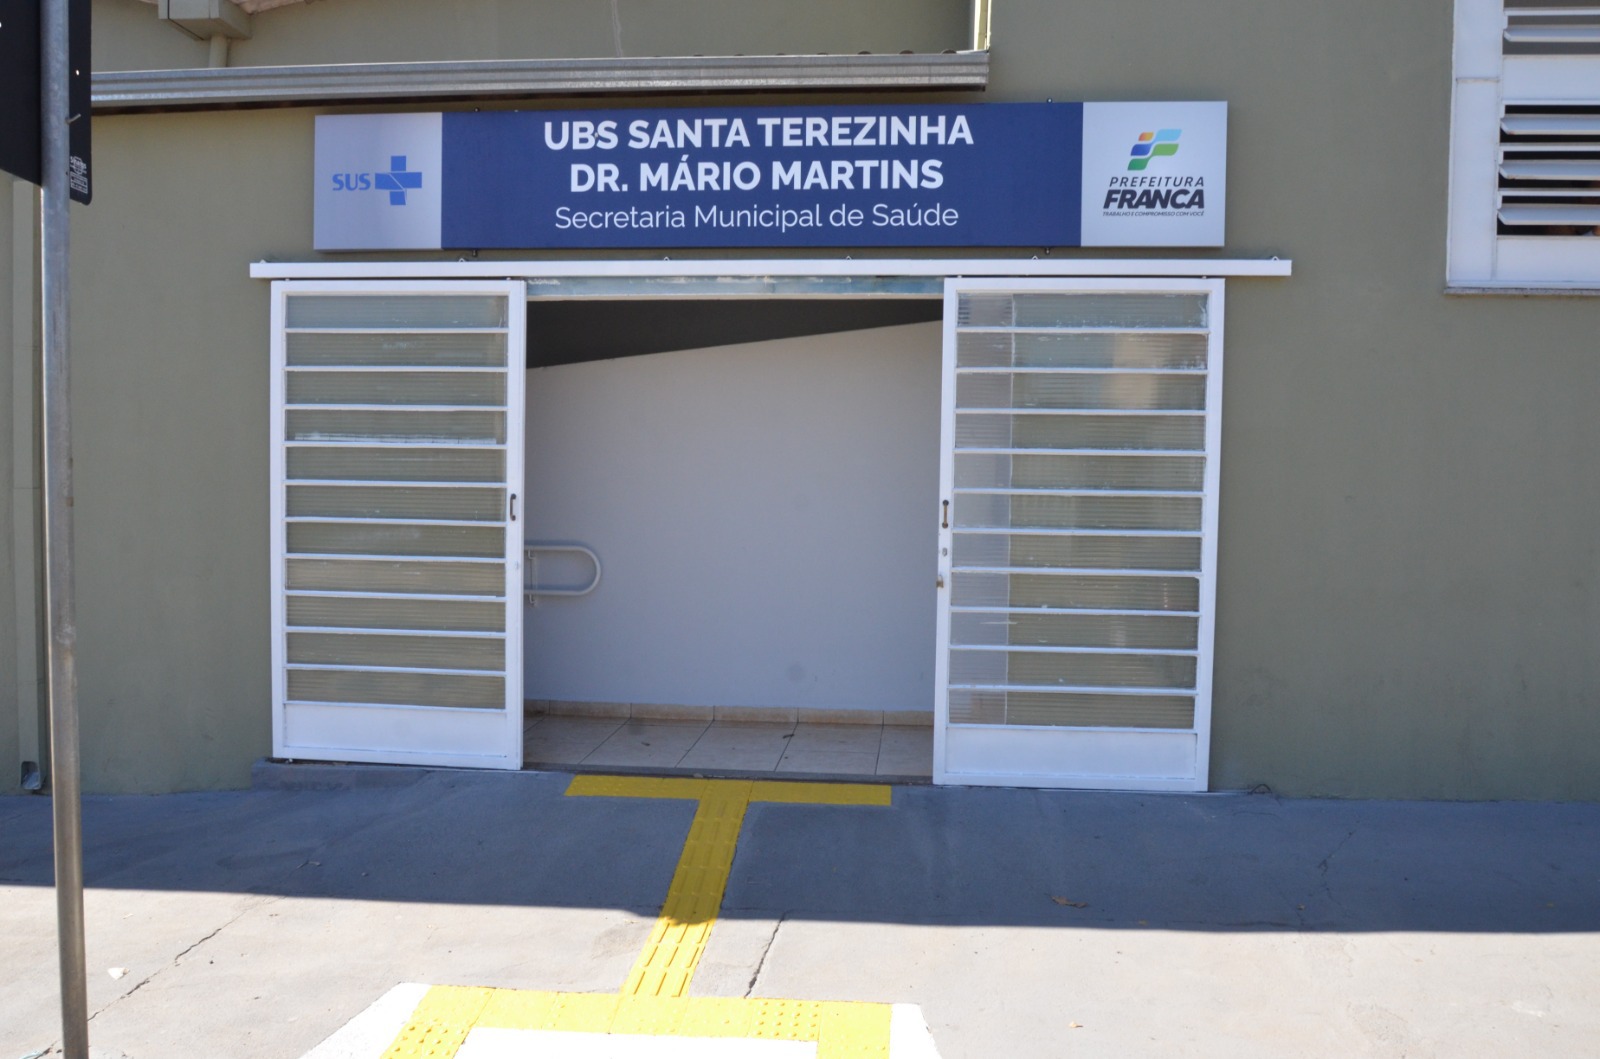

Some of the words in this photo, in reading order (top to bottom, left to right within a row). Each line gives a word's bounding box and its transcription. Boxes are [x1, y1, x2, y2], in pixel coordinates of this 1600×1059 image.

[544, 121, 619, 151] UBS
[628, 118, 751, 149] SANTA
[757, 115, 974, 147] TEREZINHA
[332, 173, 371, 191] SUS
[570, 163, 629, 193] DR.
[640, 154, 761, 192] MÁRIO
[771, 159, 944, 190] MARTINS
[1109, 176, 1205, 188] PREFEITURA
[1102, 189, 1205, 210] FRANCA
[555, 206, 686, 229] Secretaria
[695, 203, 823, 233] Municipal
[830, 204, 864, 227] de
[872, 203, 959, 227] Saúde
